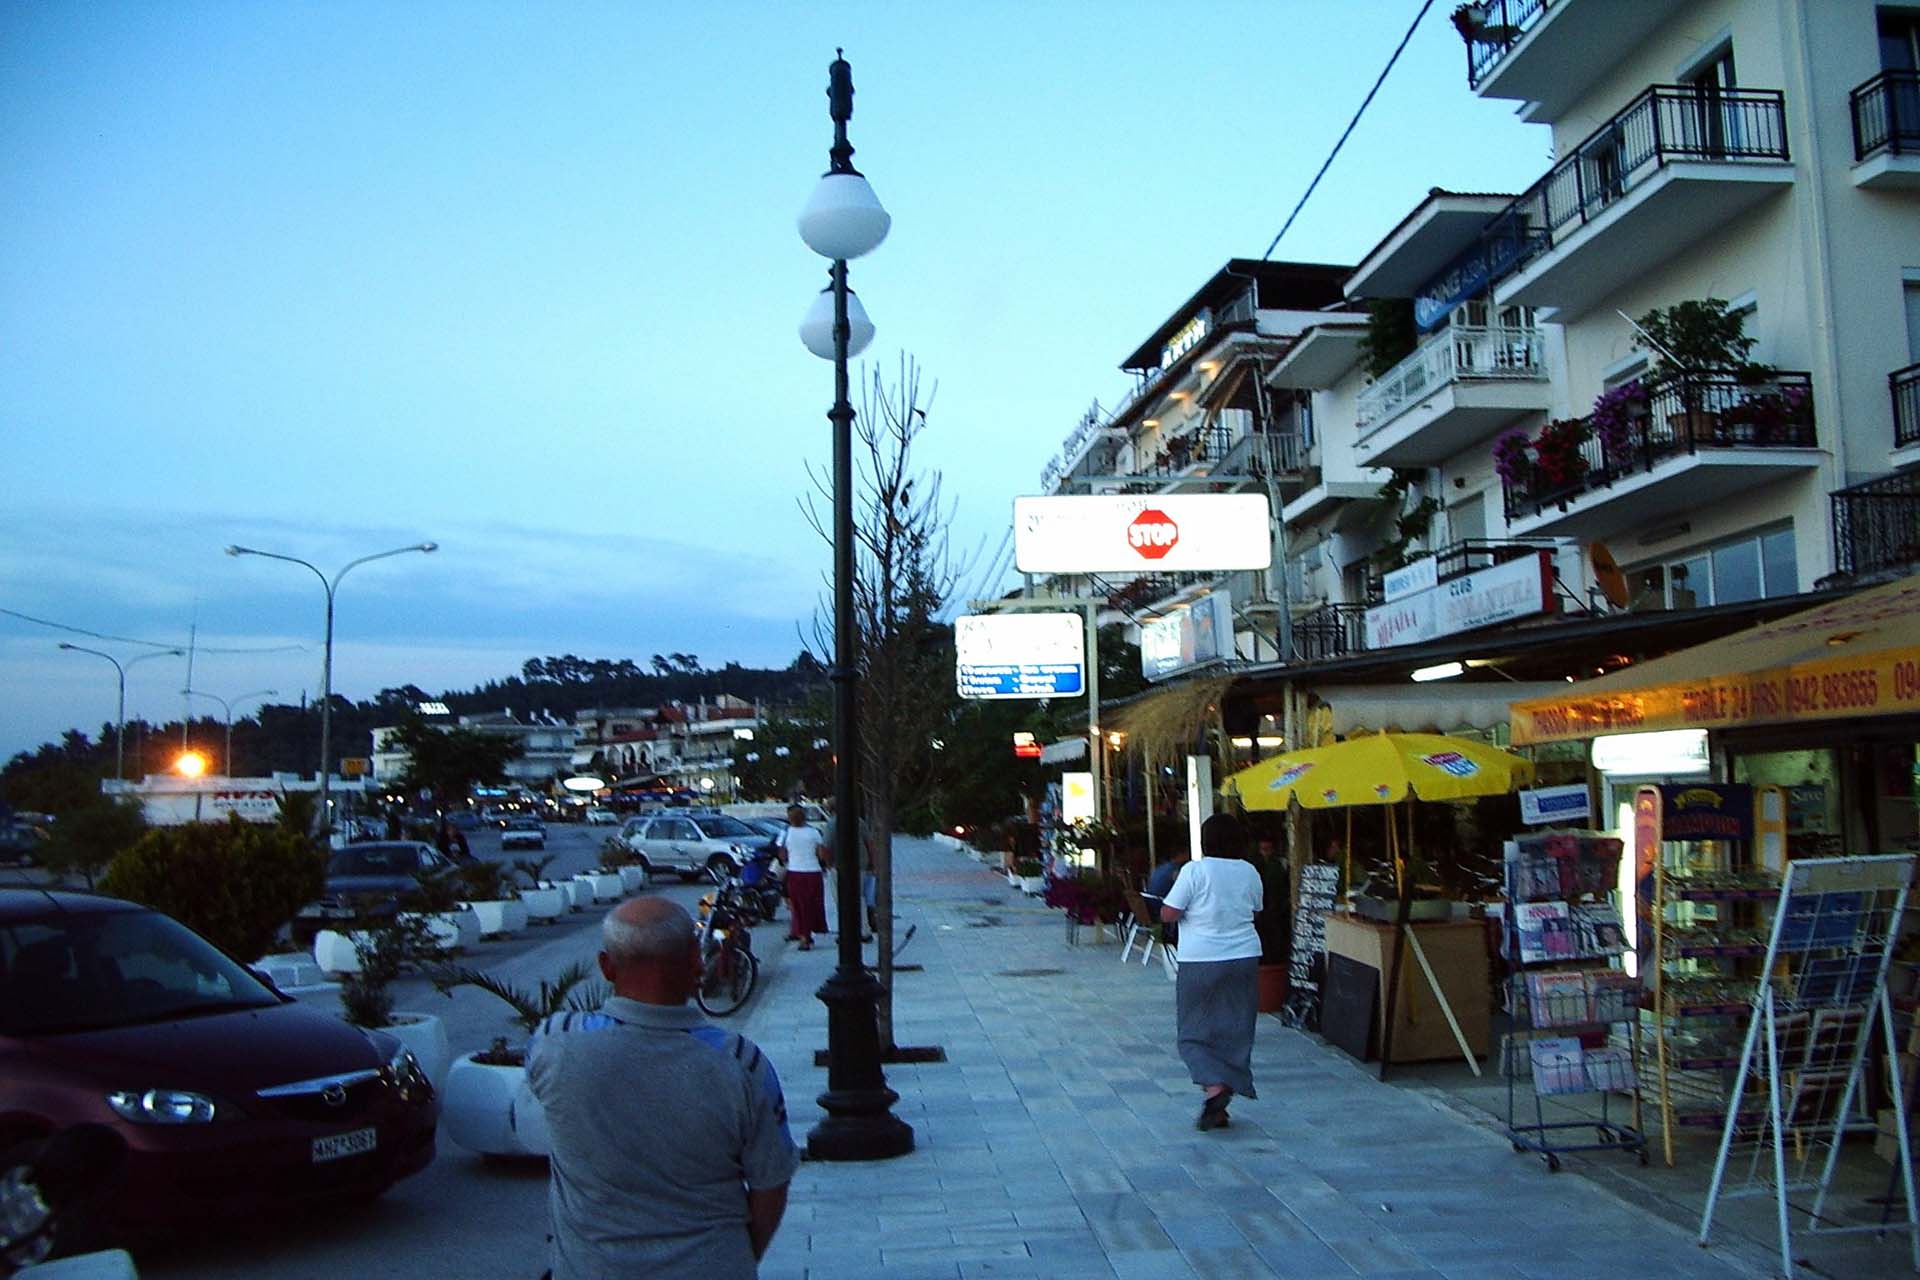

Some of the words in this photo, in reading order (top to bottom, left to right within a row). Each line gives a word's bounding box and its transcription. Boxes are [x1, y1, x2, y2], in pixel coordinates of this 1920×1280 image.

[1129, 523, 1178, 547] STOP
[1732, 686, 1747, 720] 24
[1785, 674, 1818, 713] 0942
